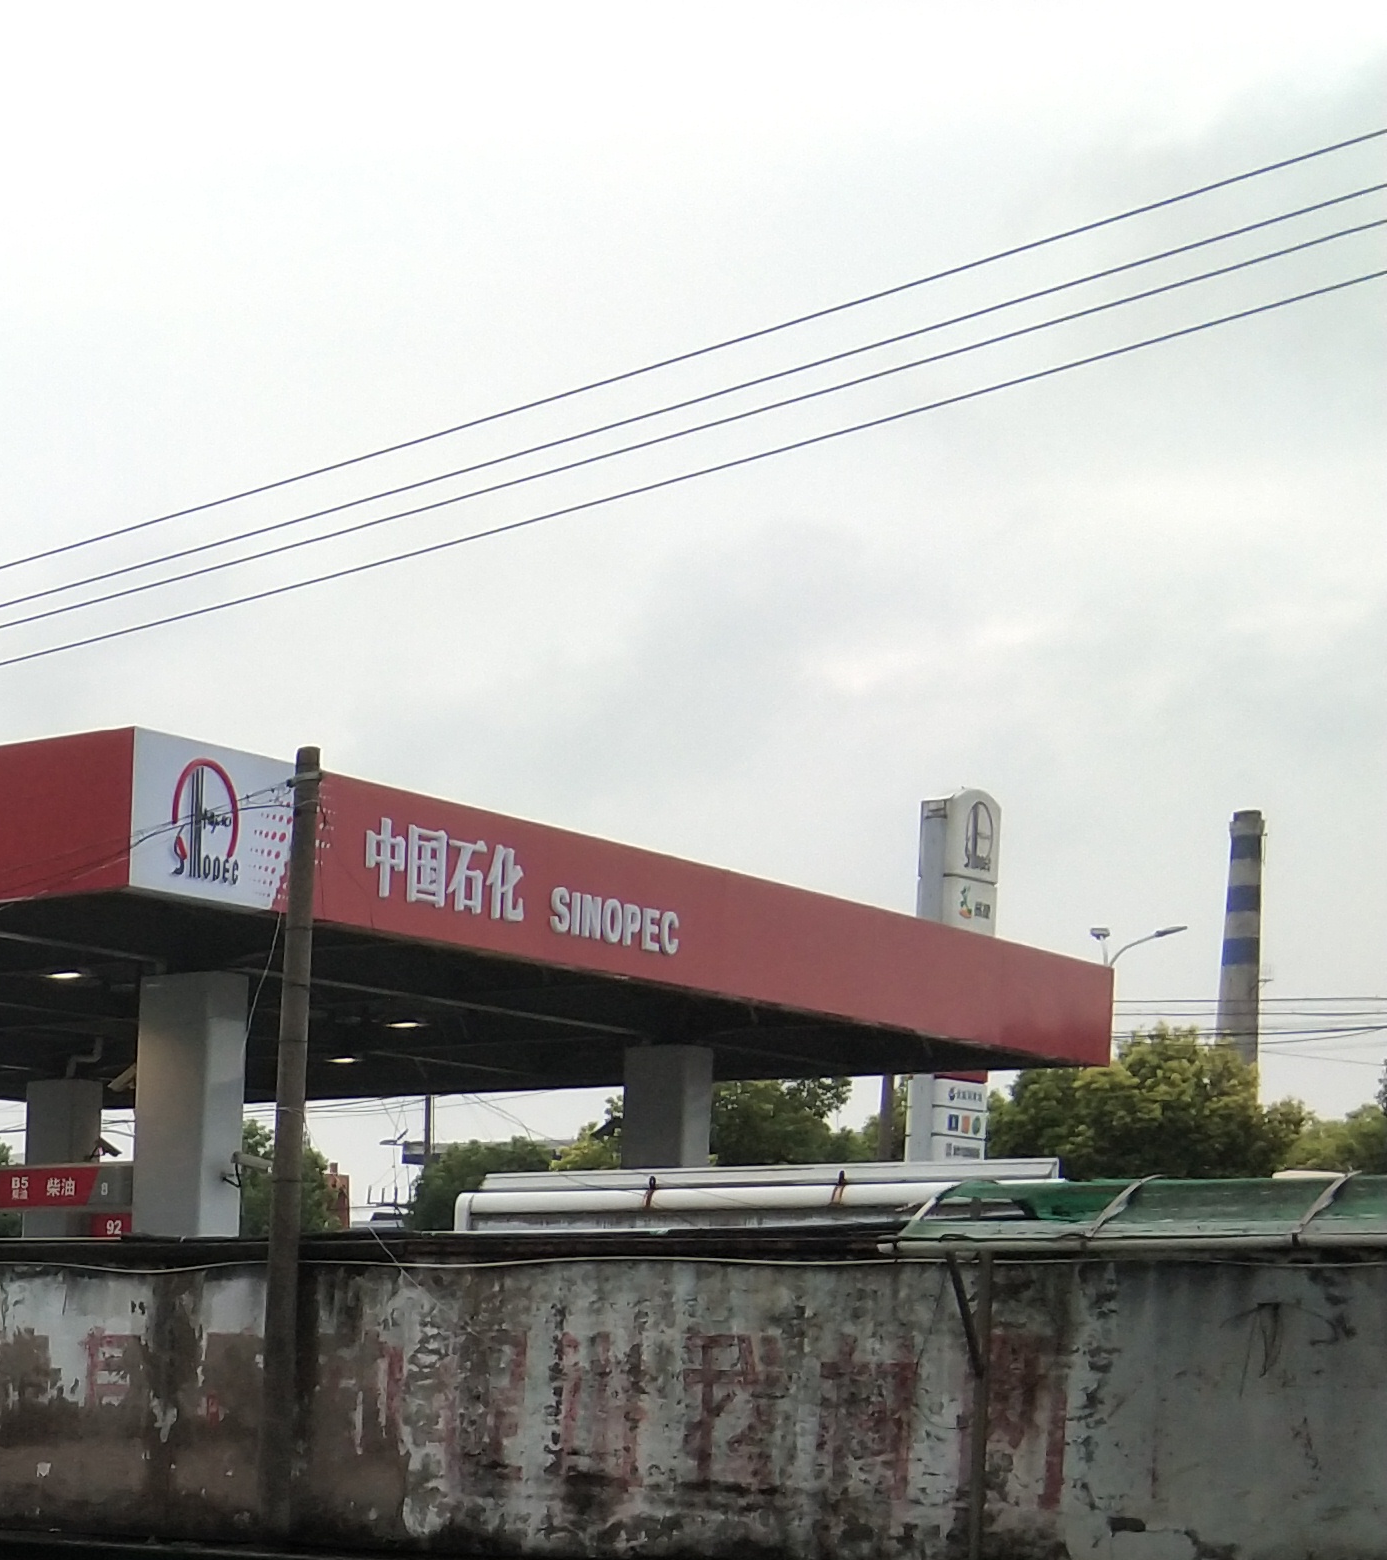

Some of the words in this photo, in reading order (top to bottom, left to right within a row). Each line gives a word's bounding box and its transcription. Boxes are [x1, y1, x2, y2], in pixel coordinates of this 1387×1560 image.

[365, 817, 524, 922] 中国石化
[549, 886, 680, 956] SINOPEC
[11, 1176, 29, 1189] B5
[46, 1177, 76, 1197] 柴油
[106, 1220, 122, 1235] 92
